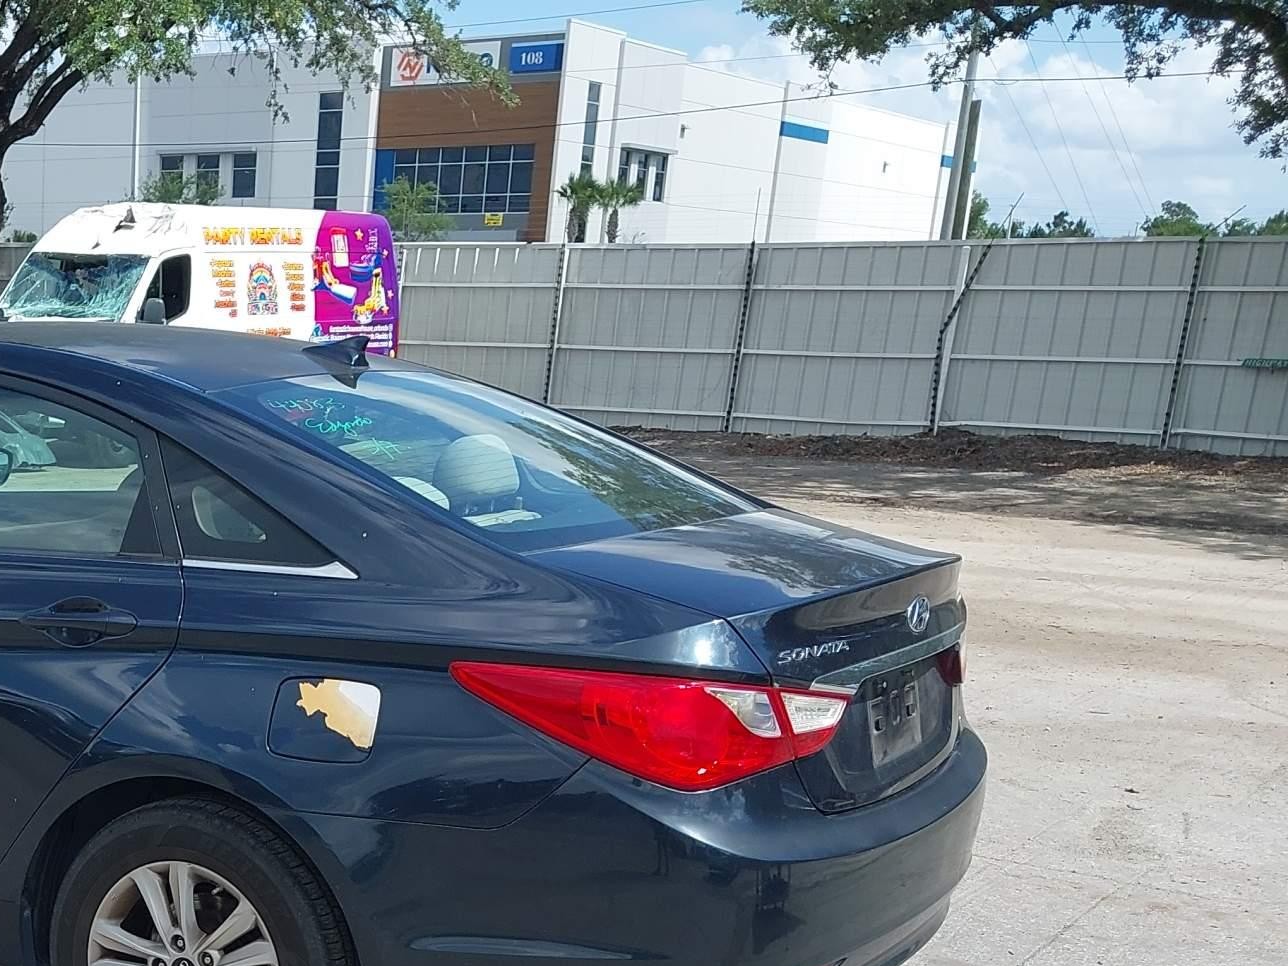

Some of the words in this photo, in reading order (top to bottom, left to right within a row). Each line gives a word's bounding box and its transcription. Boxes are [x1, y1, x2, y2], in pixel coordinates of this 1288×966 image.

[520, 52, 544, 66] 108
[202, 226, 245, 246] PARTY
[248, 226, 304, 246] RENTALS
[777, 640, 850, 665] SONATA
